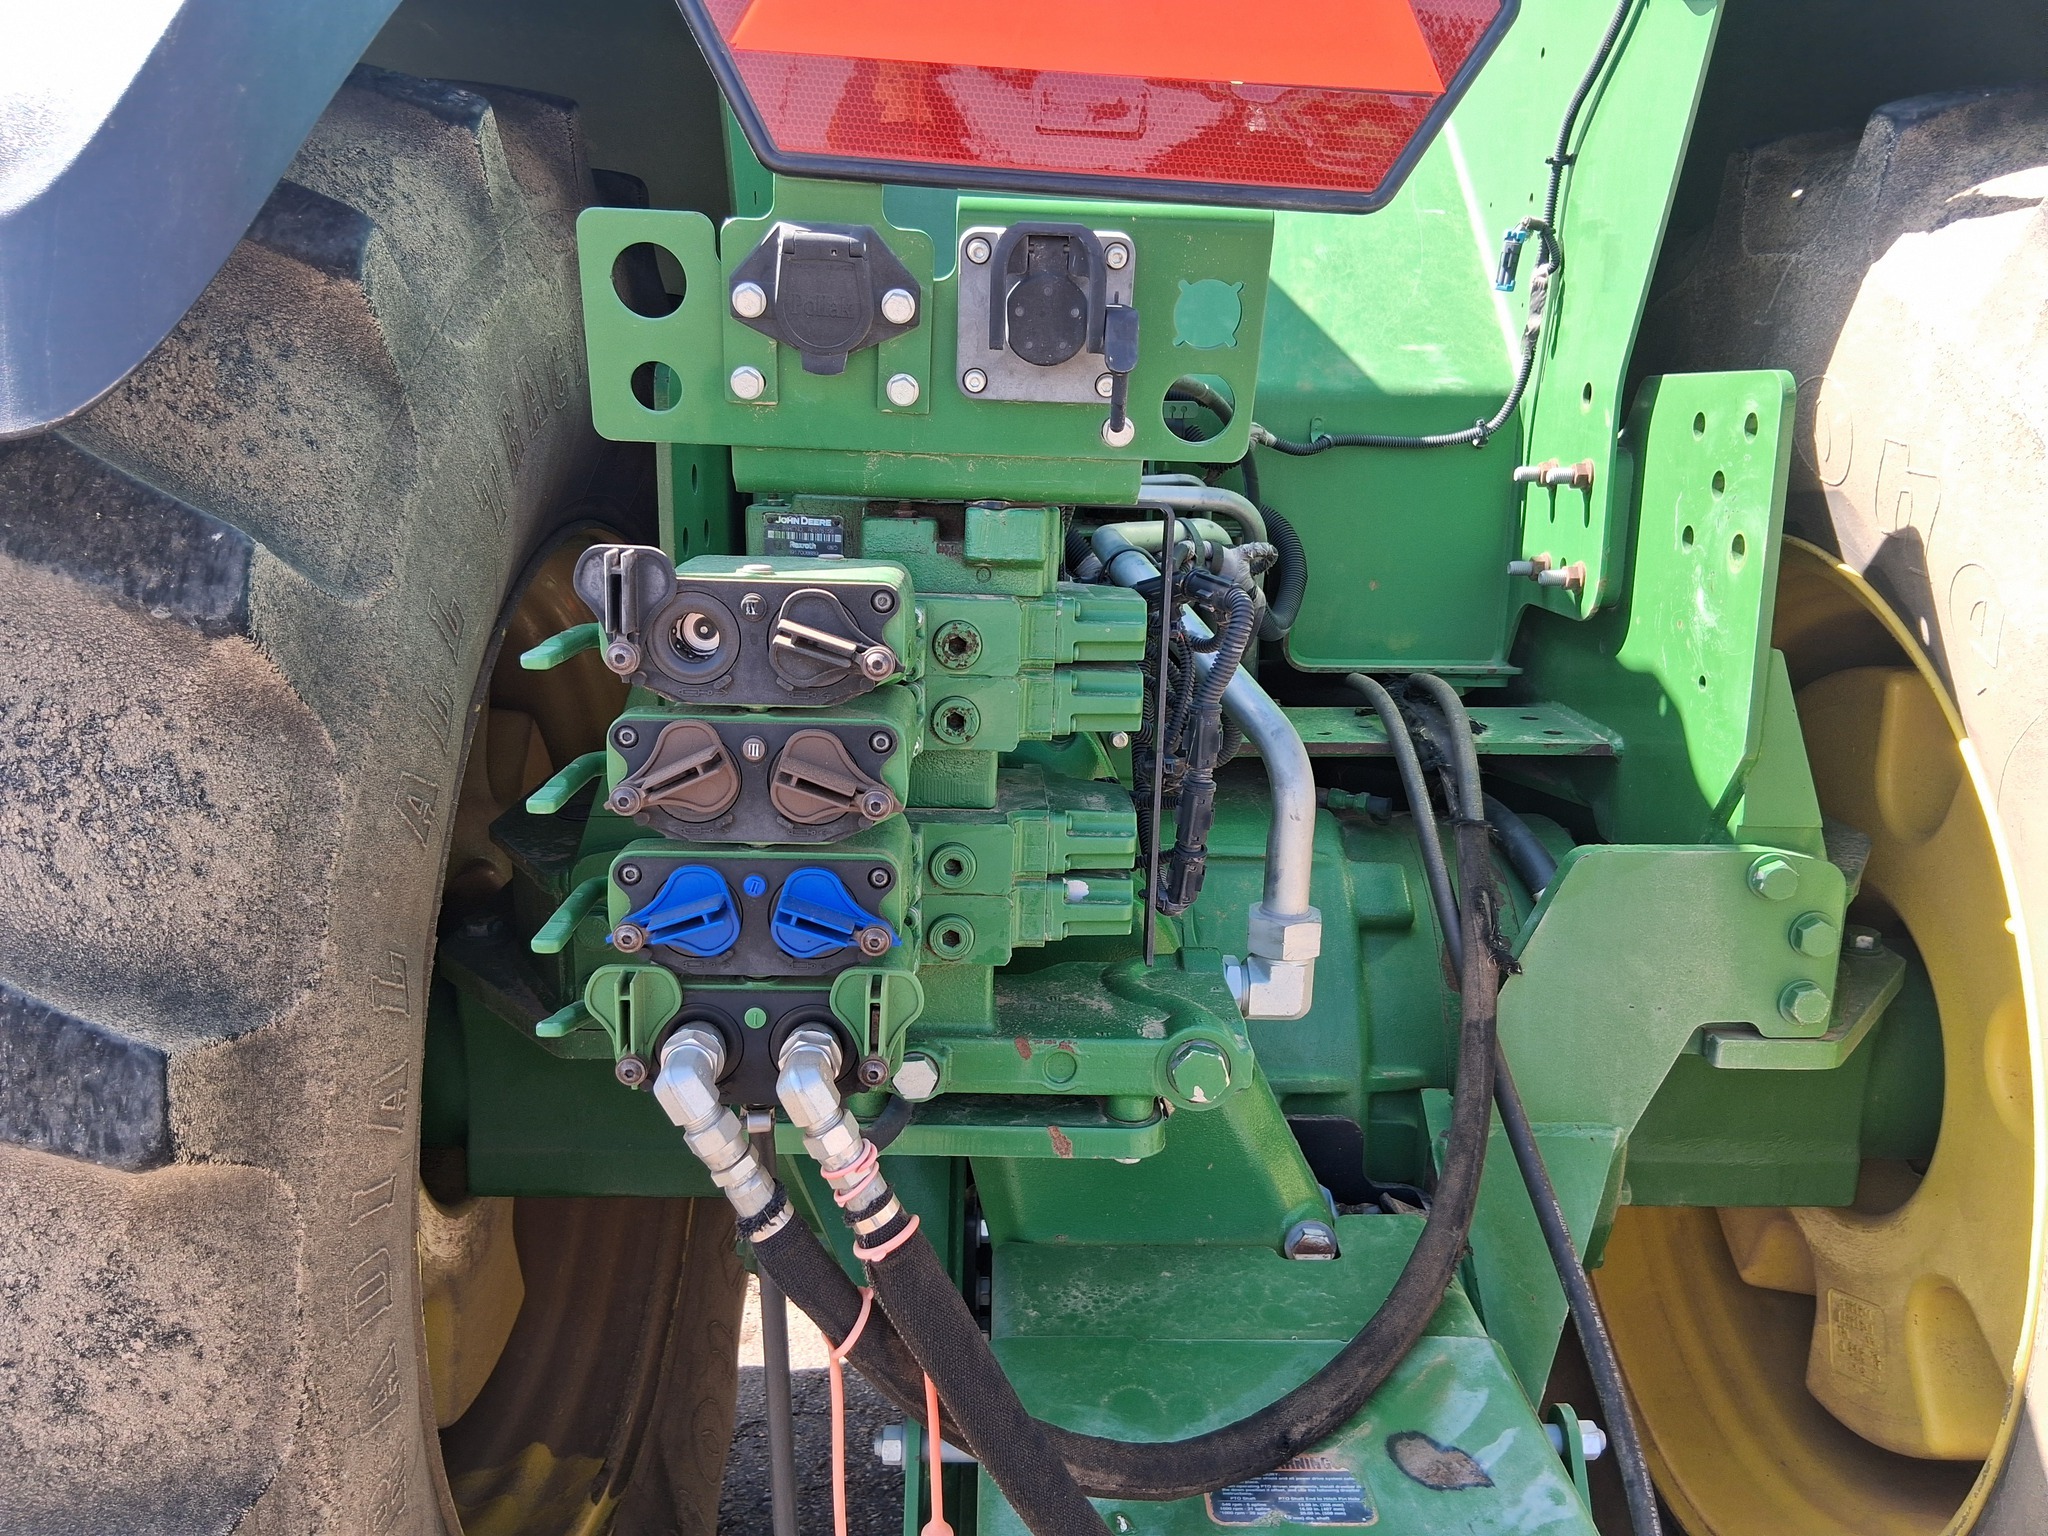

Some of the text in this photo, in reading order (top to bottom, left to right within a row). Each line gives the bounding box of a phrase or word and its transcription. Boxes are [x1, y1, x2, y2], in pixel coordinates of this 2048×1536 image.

[790, 293, 855, 319] Pollak
[775, 515, 832, 527] JOHN DEERE
[789, 541, 817, 550] Rexroth
